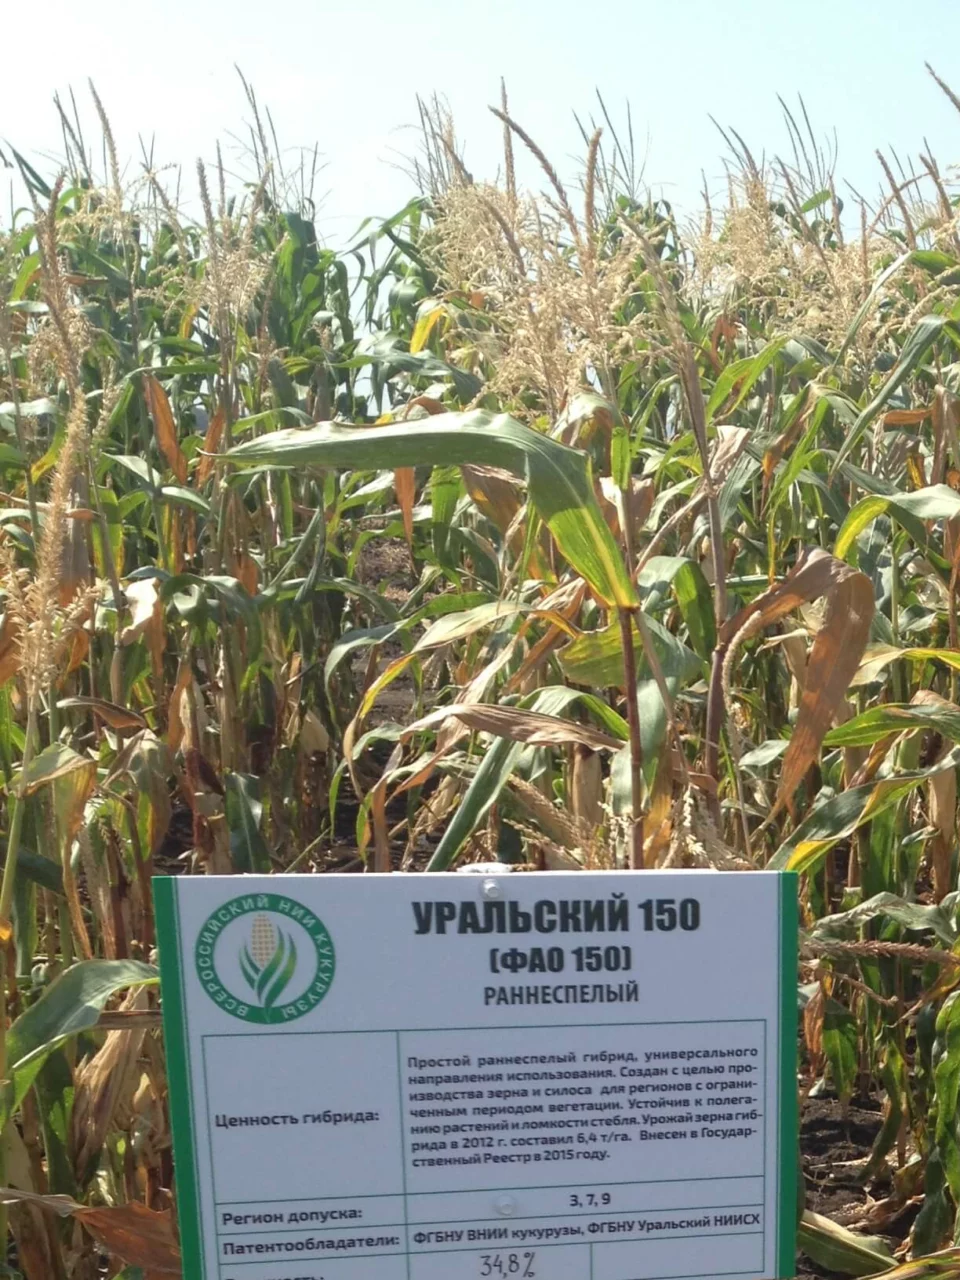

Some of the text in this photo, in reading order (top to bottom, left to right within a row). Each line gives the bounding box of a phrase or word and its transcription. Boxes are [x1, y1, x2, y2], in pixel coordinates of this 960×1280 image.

[413, 893, 701, 934] УРАЛЬСКИЙ 150
[199, 894, 332, 1018] ВСЕРОССИЙСКИЙ НИИ КУКУРУЗЫ
[483, 980, 639, 1006] РАННЕСПЕЛЫЙ
[408, 1055, 471, 1069] Простой
[477, 1053, 576, 1068] раннеспелый
[645, 1047, 758, 1063] универсального
[409, 1063, 757, 1085] направления использования. Создан с целью про-
[409, 1079, 757, 1102] изводства зерна и силоса для регионов с ограни-
[410, 1095, 757, 1118] ченным периодом вегетации. Устойчив к полега-
[215, 1107, 380, 1130] Ценность гибрида:
[411, 1109, 763, 1134] нию растений и ломкости стебля. Урожай зерна гиб-
[411, 1127, 757, 1154] рида в 2012 г. составил 6,4 т/га. Внесен в Государ-
[412, 1150, 610, 1167] ственный Реестр в 2015 году.
[569, 1192, 611, 1208] 3, 7, 9
[222, 1208, 363, 1228] Регион допуска:
[413, 1213, 760, 1245] ФГБНУ ВНИИ кукурузы, ФГБНУ Уральский НИИСХ
[222, 1236, 400, 1256] Патентообладатели:
[480, 1252, 536, 1279] 34,8%
